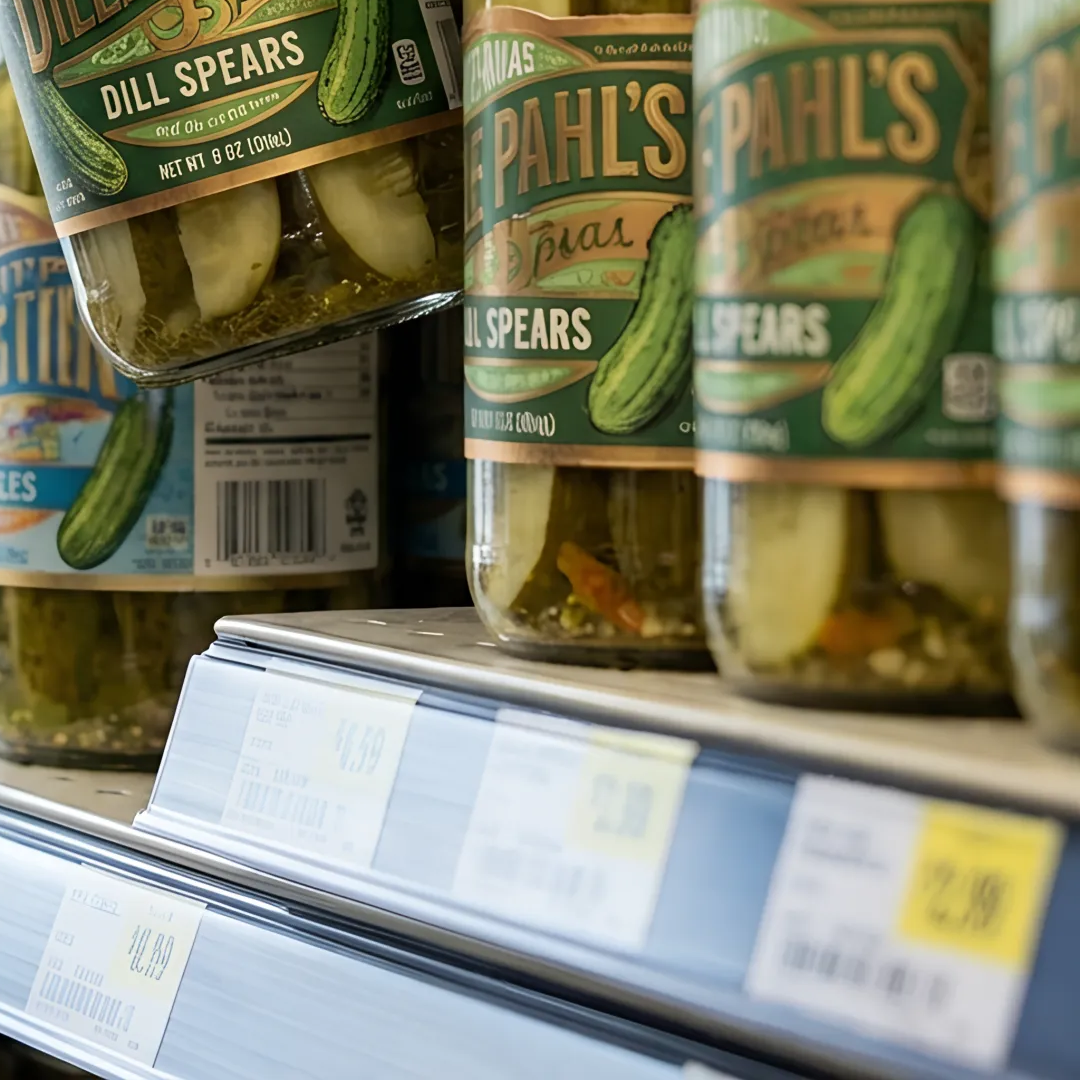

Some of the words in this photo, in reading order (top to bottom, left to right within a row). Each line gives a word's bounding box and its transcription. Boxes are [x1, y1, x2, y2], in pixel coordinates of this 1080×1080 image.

[99, 71, 170, 120] DILL
[174, 30, 305, 98] SPEARS
[720, 50, 941, 195] PAHL'S
[494, 79, 688, 209] PAHL'S
[486, 307, 593, 351] SPEARS
